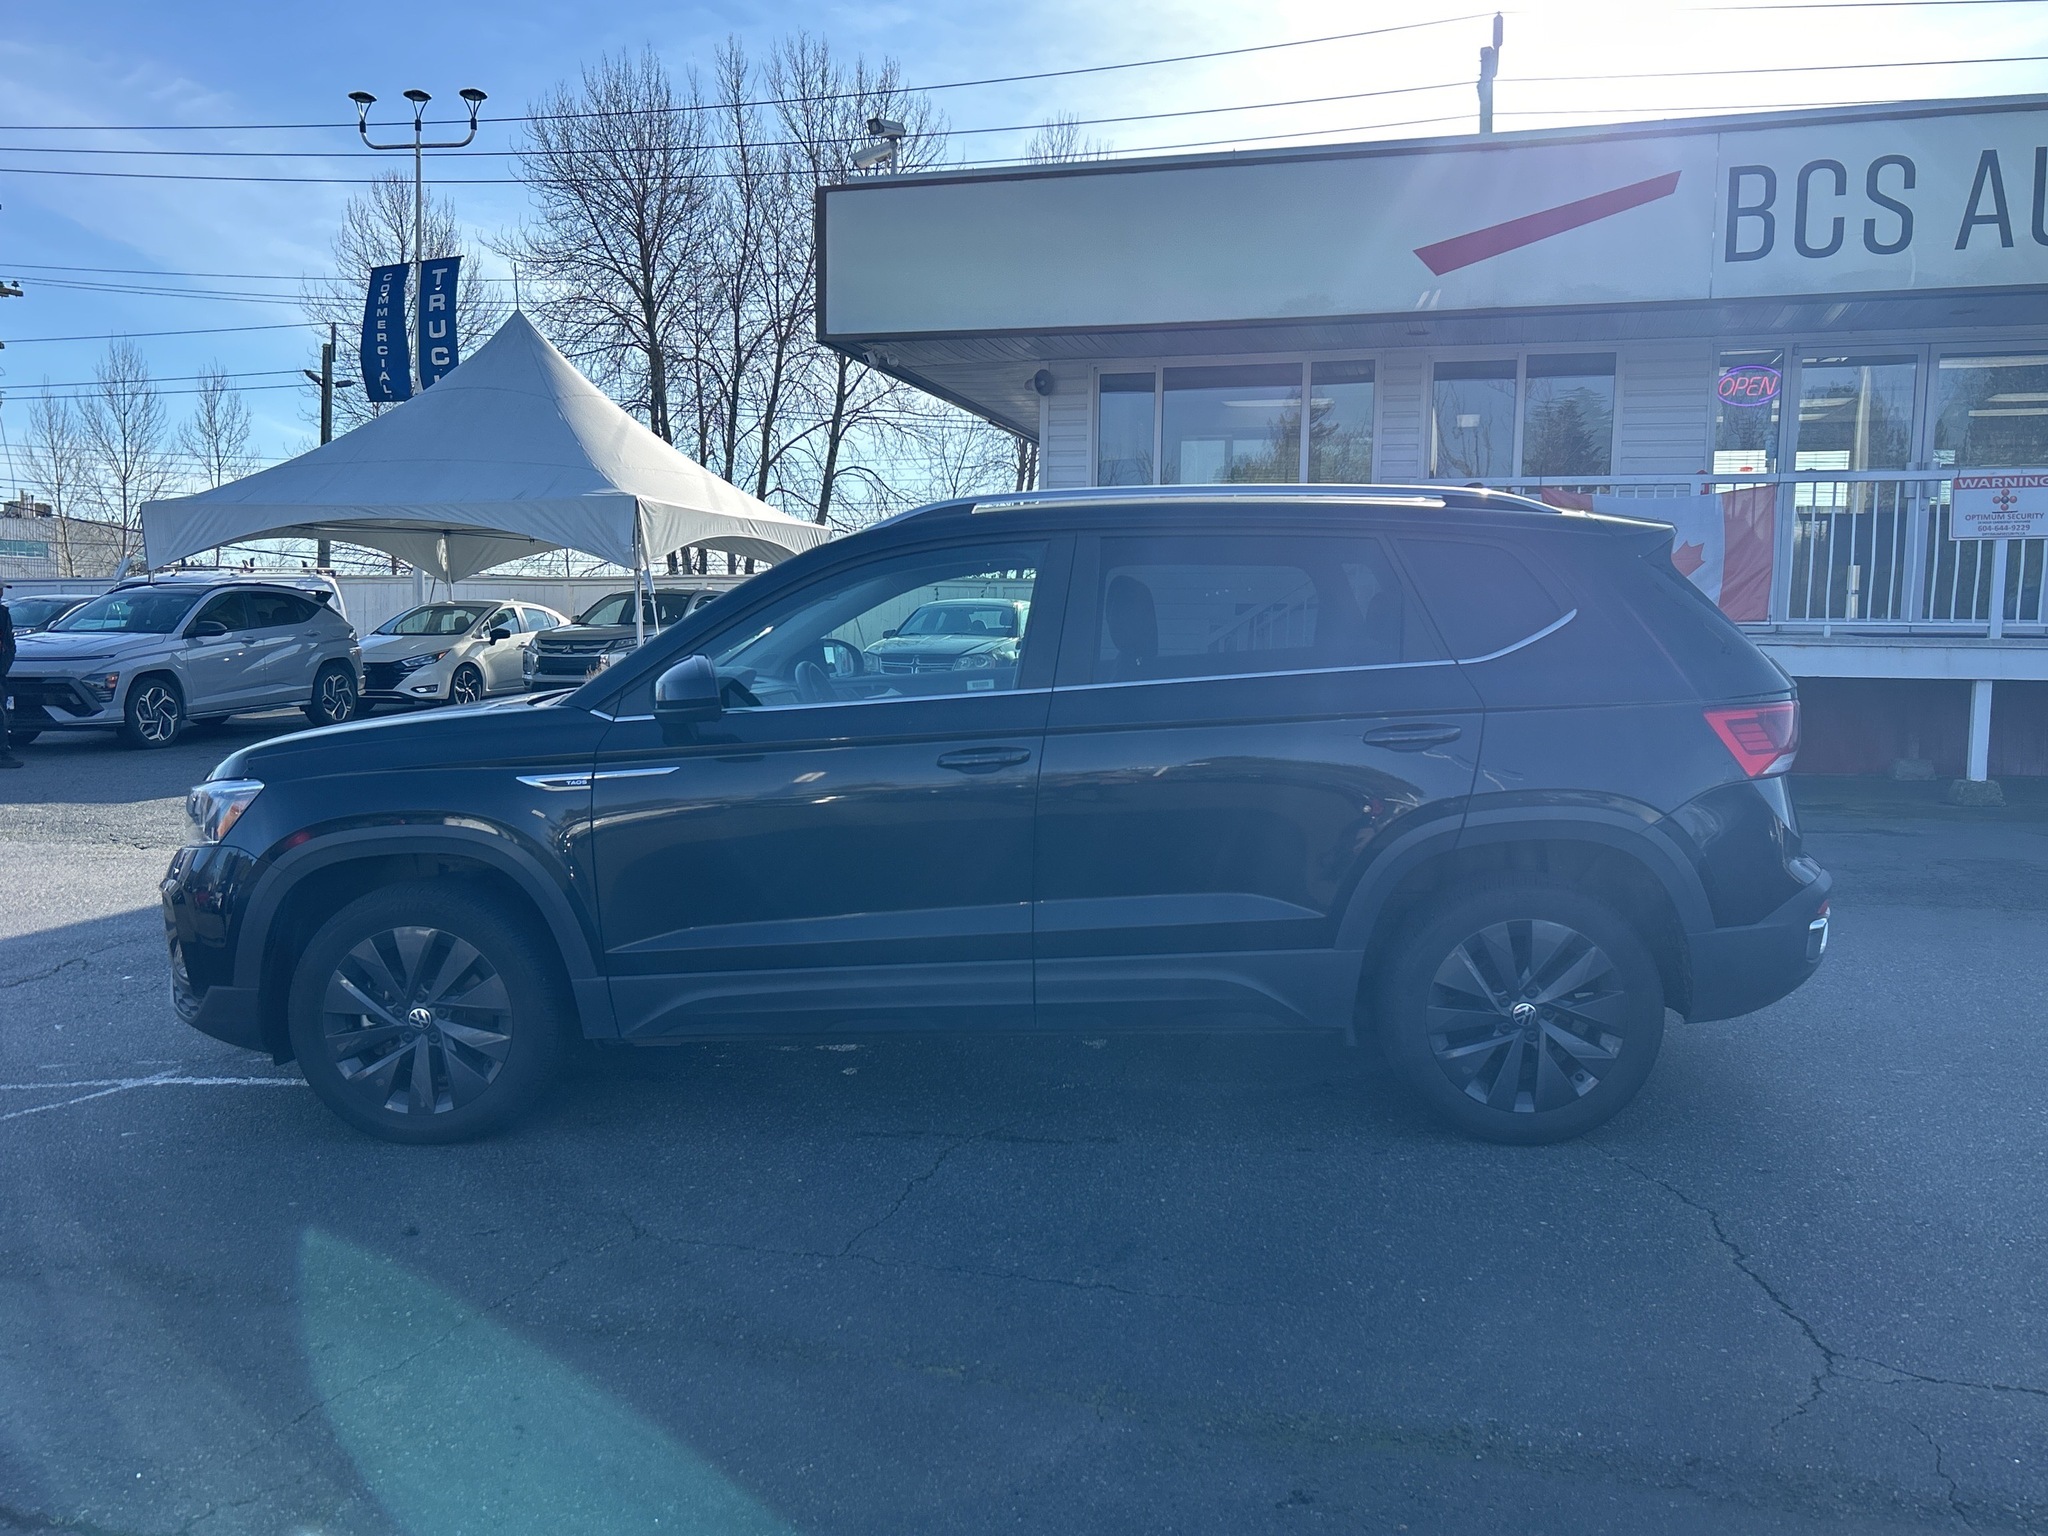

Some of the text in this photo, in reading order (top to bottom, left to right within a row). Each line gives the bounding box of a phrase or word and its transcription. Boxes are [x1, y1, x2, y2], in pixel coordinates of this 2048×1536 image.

[1725, 154, 1916, 263] BCS
[376, 272, 393, 394] COMMERCIAL
[1718, 376, 1778, 396] OPEN
[1958, 477, 2048, 488] WARNING
[2007, 512, 2045, 520] SECURITY
[1977, 524, 2031, 532] 604-644-9229
